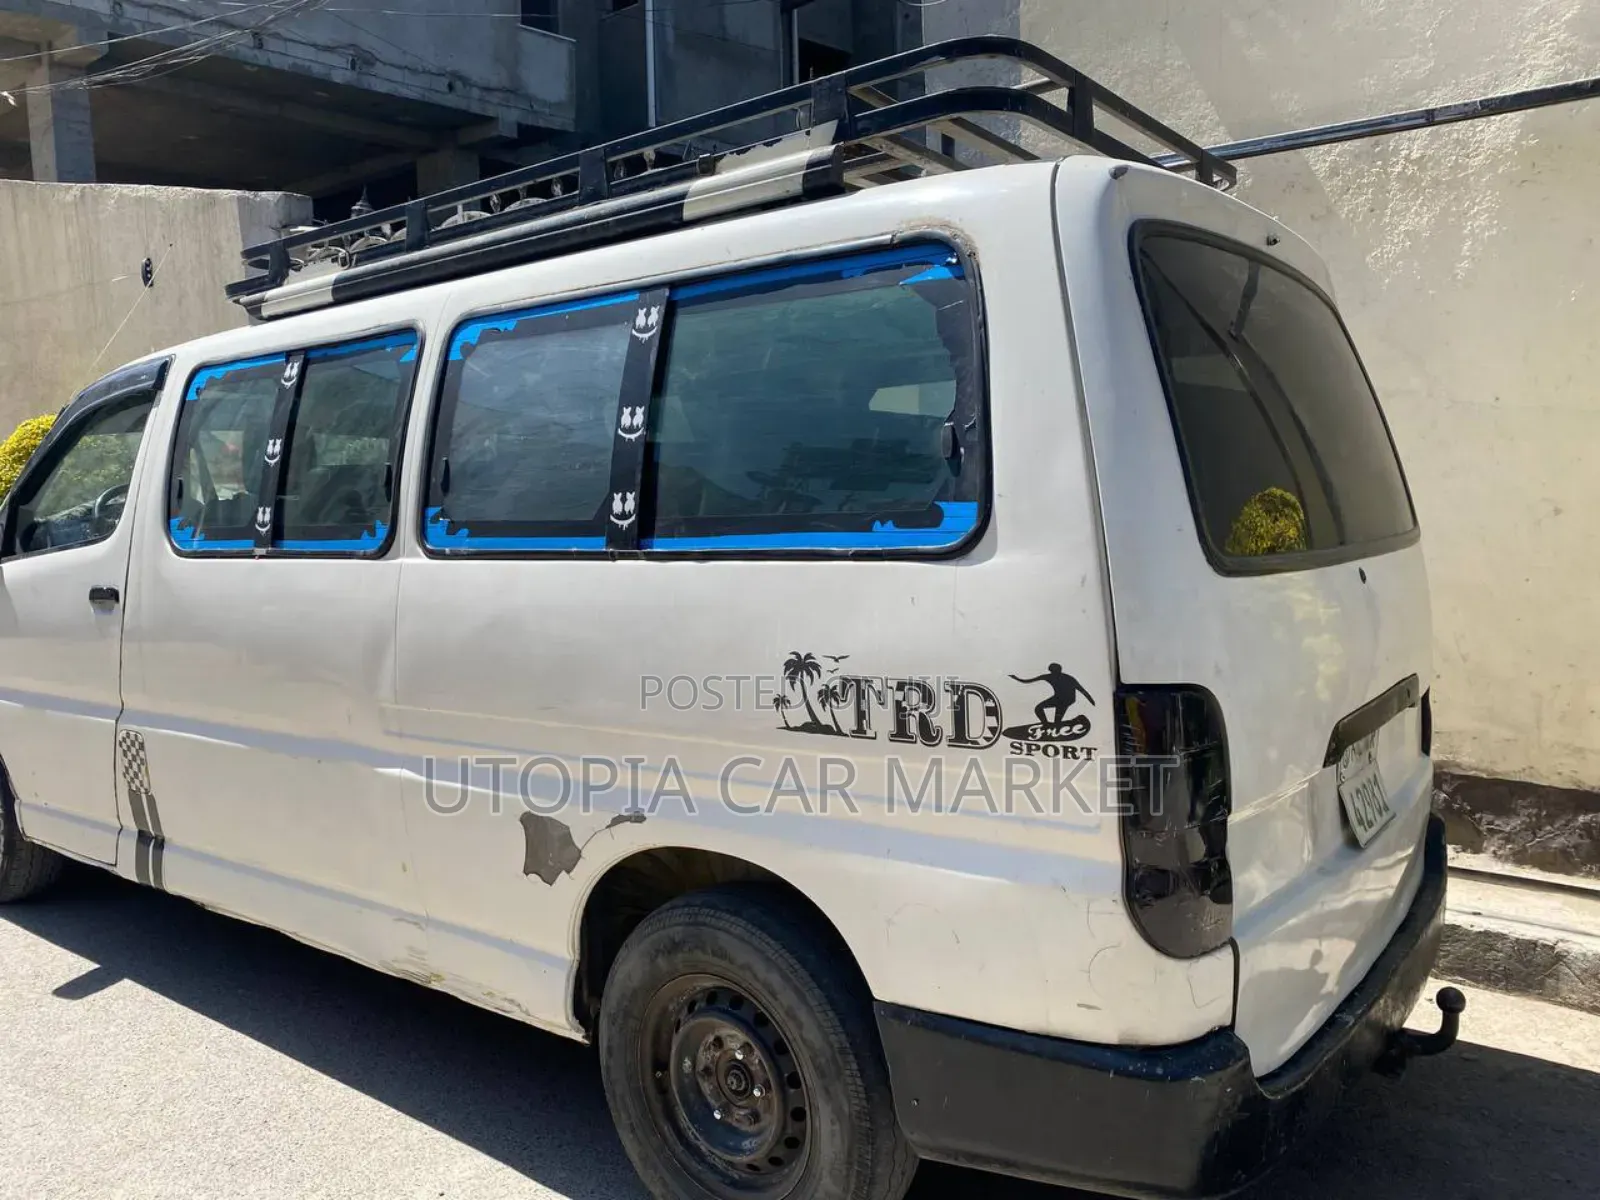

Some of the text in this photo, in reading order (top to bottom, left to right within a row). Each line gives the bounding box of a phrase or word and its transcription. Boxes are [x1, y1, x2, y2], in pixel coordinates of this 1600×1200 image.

[839, 674, 1003, 750] TRD
[1027, 723, 1087, 740] Free
[1009, 741, 1097, 761] SPORT
